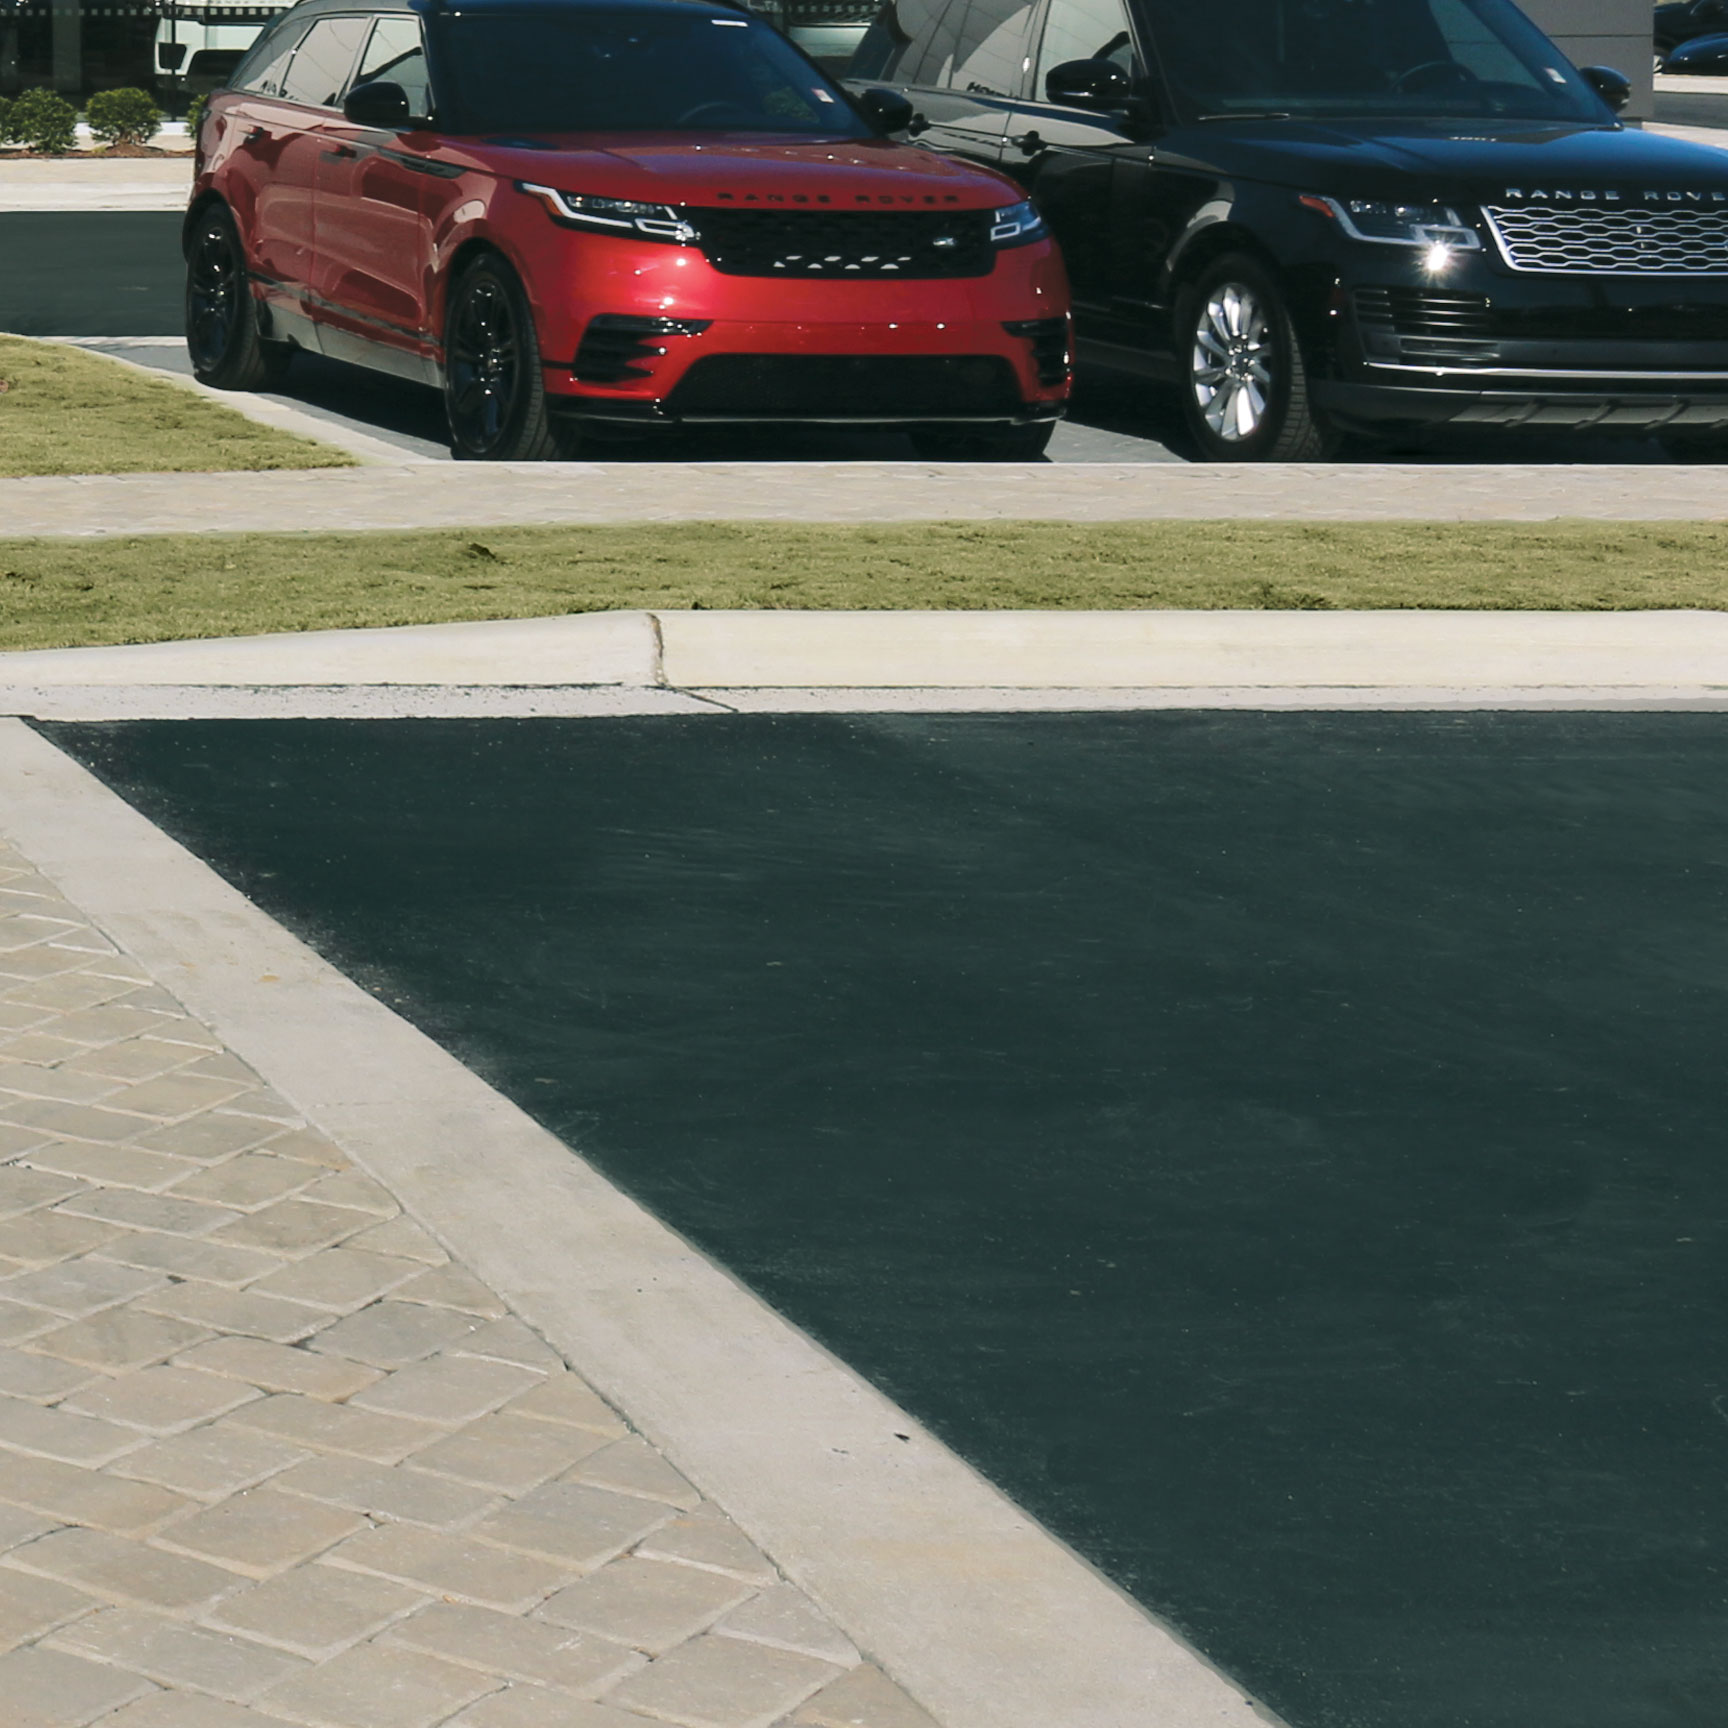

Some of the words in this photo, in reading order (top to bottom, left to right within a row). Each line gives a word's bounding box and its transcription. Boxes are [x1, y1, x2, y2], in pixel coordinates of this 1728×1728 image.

[716, 191, 832, 204] RANGE
[855, 193, 960, 205] ROVER
[1505, 187, 1620, 201] RANGE
